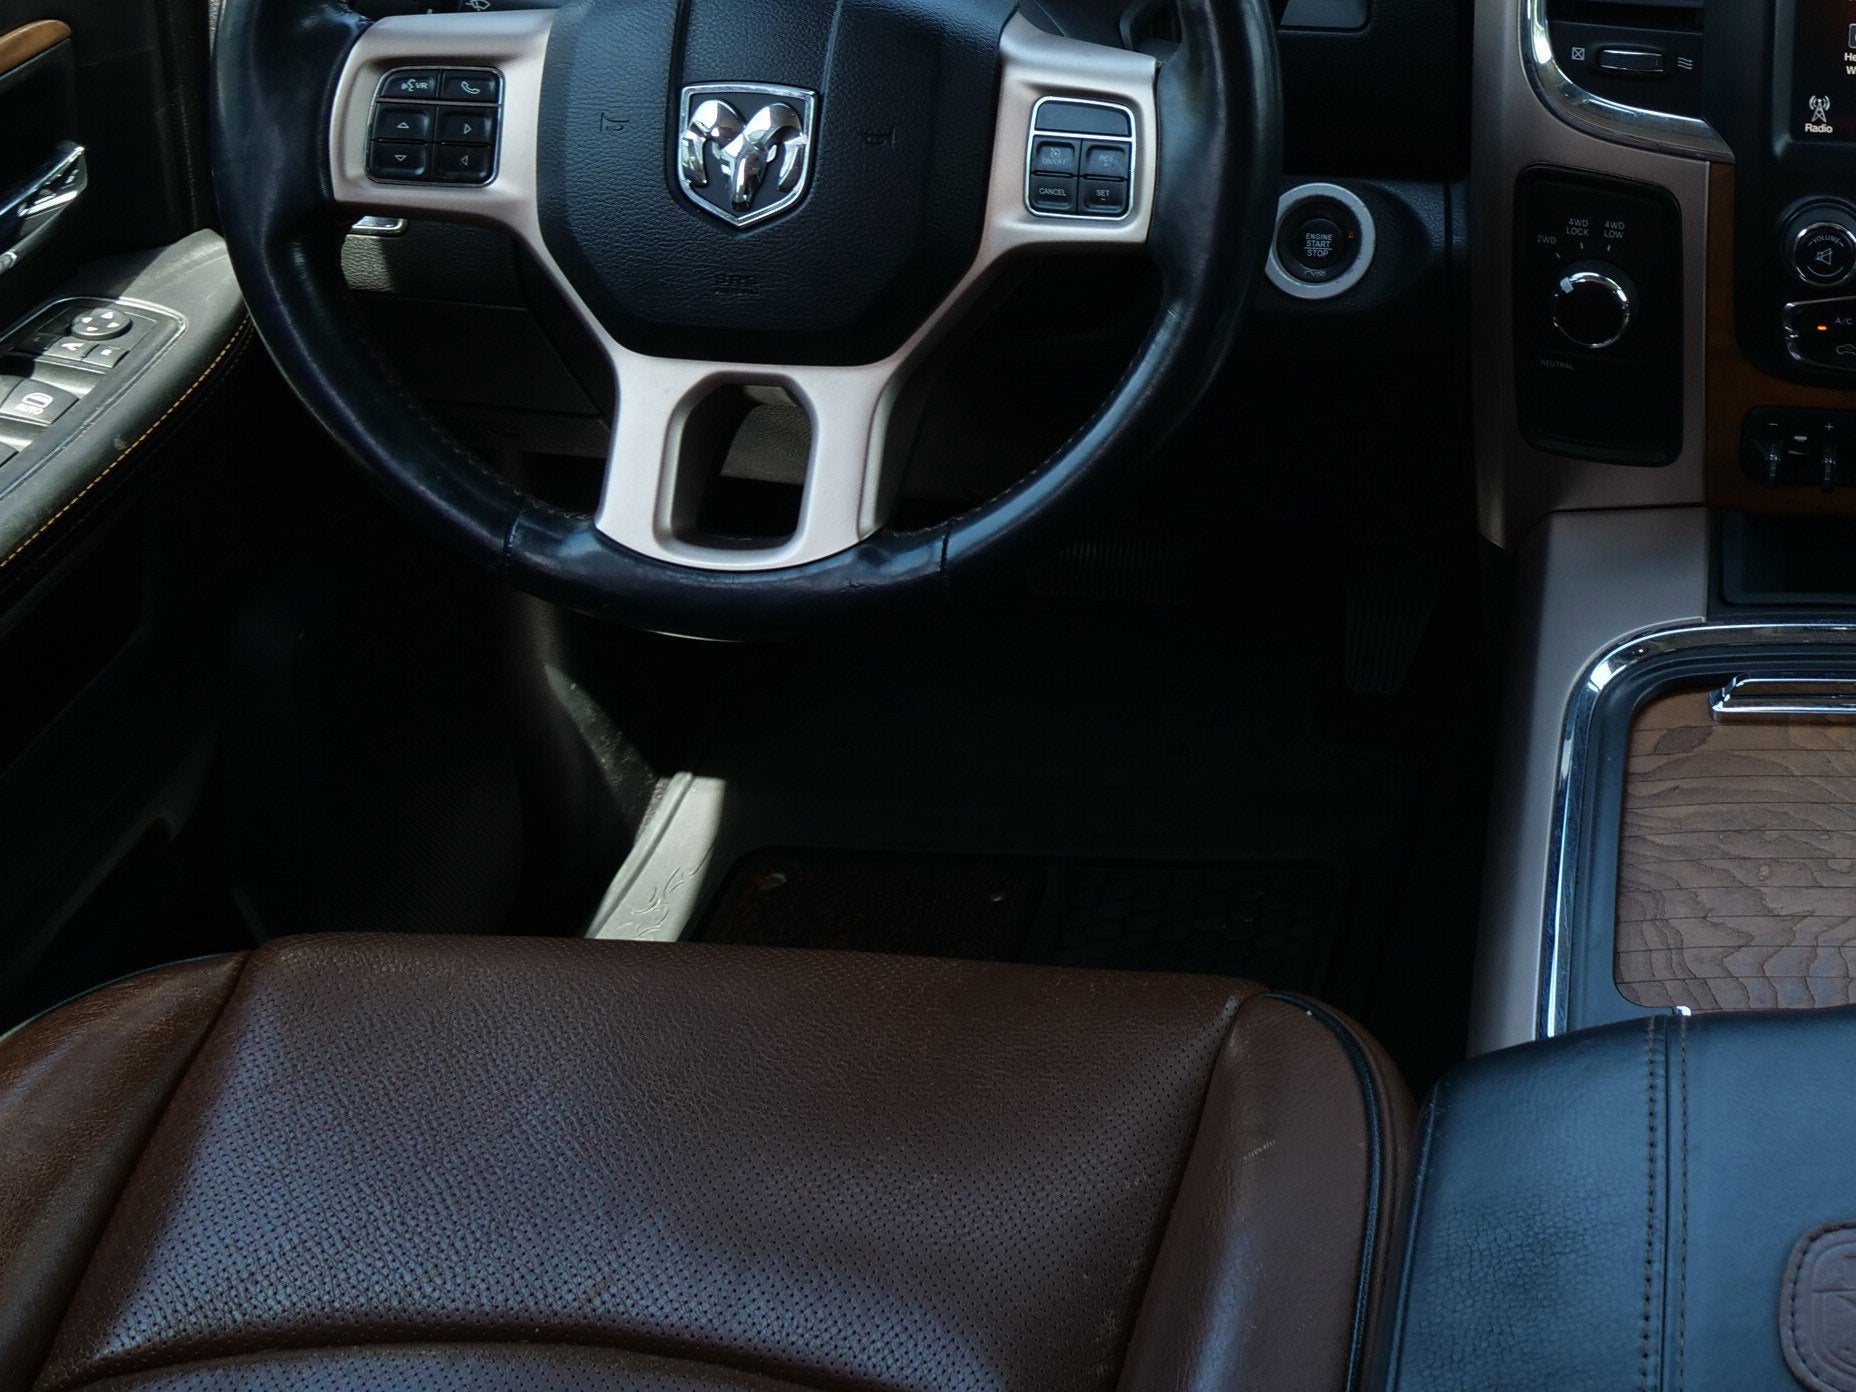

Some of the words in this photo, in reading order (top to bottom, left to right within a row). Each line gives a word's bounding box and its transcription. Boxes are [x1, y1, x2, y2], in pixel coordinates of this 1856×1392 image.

[1805, 123, 1833, 134] Radio
[1039, 188, 1066, 196] CANCEL
[1096, 189, 1110, 197] SET
[1568, 218, 1589, 228] 4WD
[1605, 221, 1626, 230] 4WD
[1566, 227, 1590, 237] LOCK
[1604, 230, 1624, 239] LOW
[1305, 233, 1333, 241] ENGINE
[1536, 235, 1557, 245] 2WD
[1811, 234, 1841, 244] VOLUME
[1306, 240, 1331, 248] START
[1307, 249, 1329, 257] STOP
[1835, 317, 1853, 325] A/C
[1540, 358, 1574, 369] NEUTRAL
